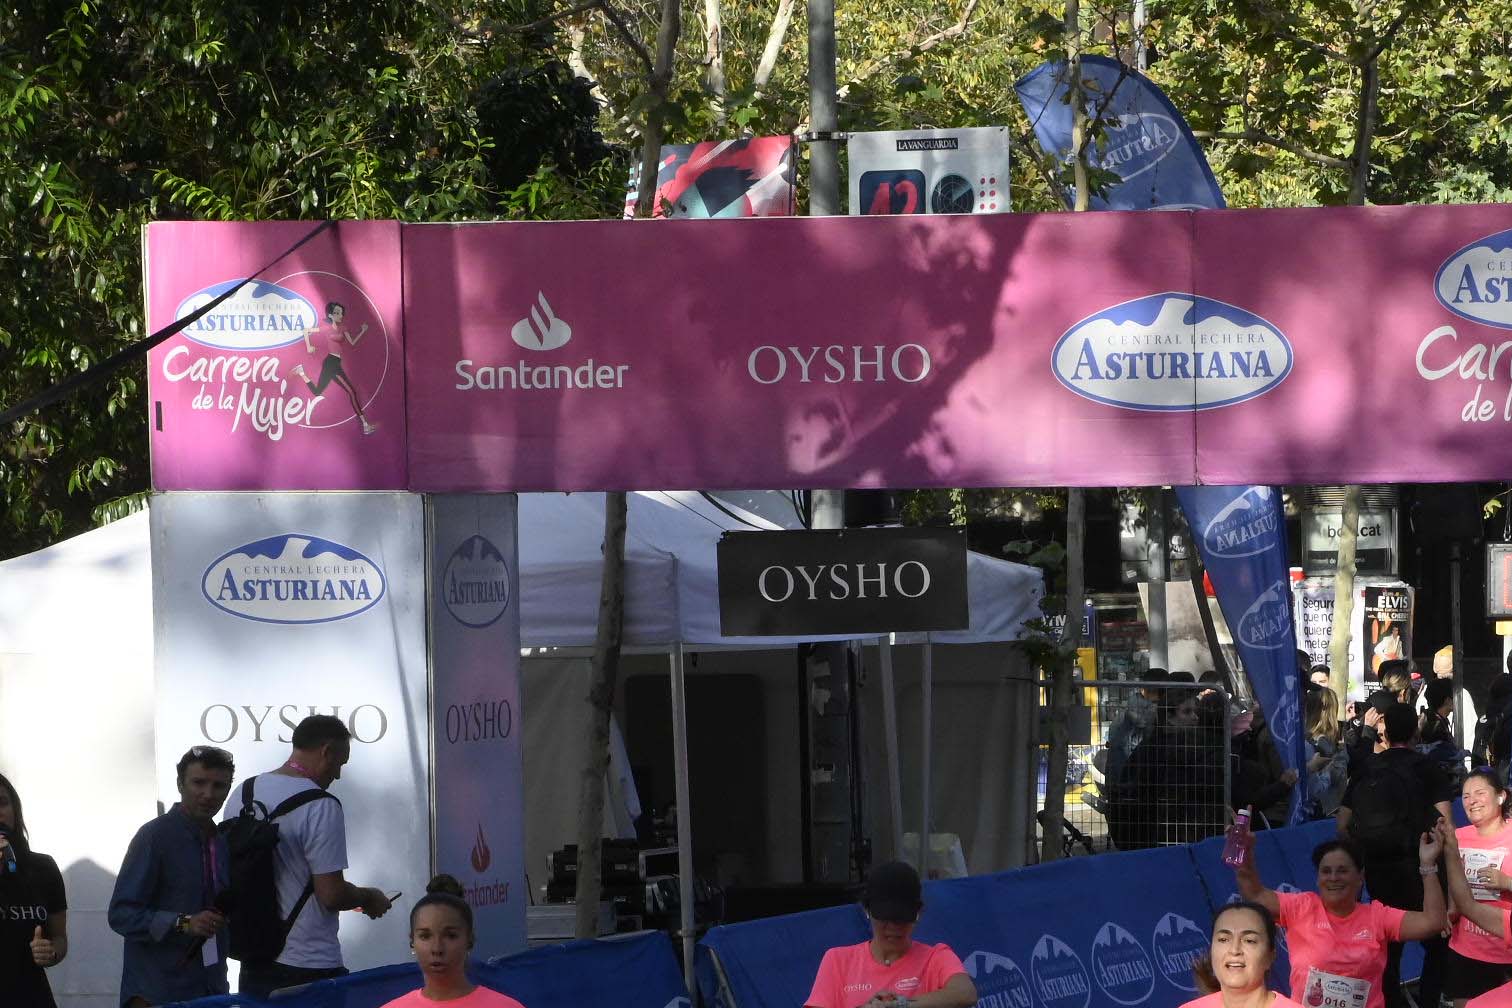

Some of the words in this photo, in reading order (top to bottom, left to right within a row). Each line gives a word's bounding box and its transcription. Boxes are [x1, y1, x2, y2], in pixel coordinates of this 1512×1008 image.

[1106, 332, 1183, 346] CENTRAL
[1189, 331, 1267, 345] LECHERA
[162, 345, 281, 384] Carrera
[455, 359, 629, 391] Santander
[747, 343, 931, 385] OYSHO
[1071, 338, 1275, 382] ASTURIANA
[191, 382, 214, 411] de
[218, 382, 235, 411] la
[231, 379, 326, 441] Mujer
[1461, 382, 1496, 422] de
[1327, 522, 1382, 539] bo.cat
[216, 568, 373, 602] ASTURIANA
[243, 565, 302, 575] CENTRAL
[307, 564, 366, 575] LECHERA
[758, 560, 931, 602] OYSHO
[1377, 595, 1409, 609] ELVIS
[1309, 653, 1324, 663] ste
[200, 703, 389, 744] OYSO
[445, 698, 513, 745] OYSHO
[1465, 867, 1478, 876] 01
[461, 879, 509, 908] ntander
[843, 983, 872, 992] OYSHO
[1099, 957, 1152, 989] ASTURIANA
[1324, 996, 1347, 1008] 016
